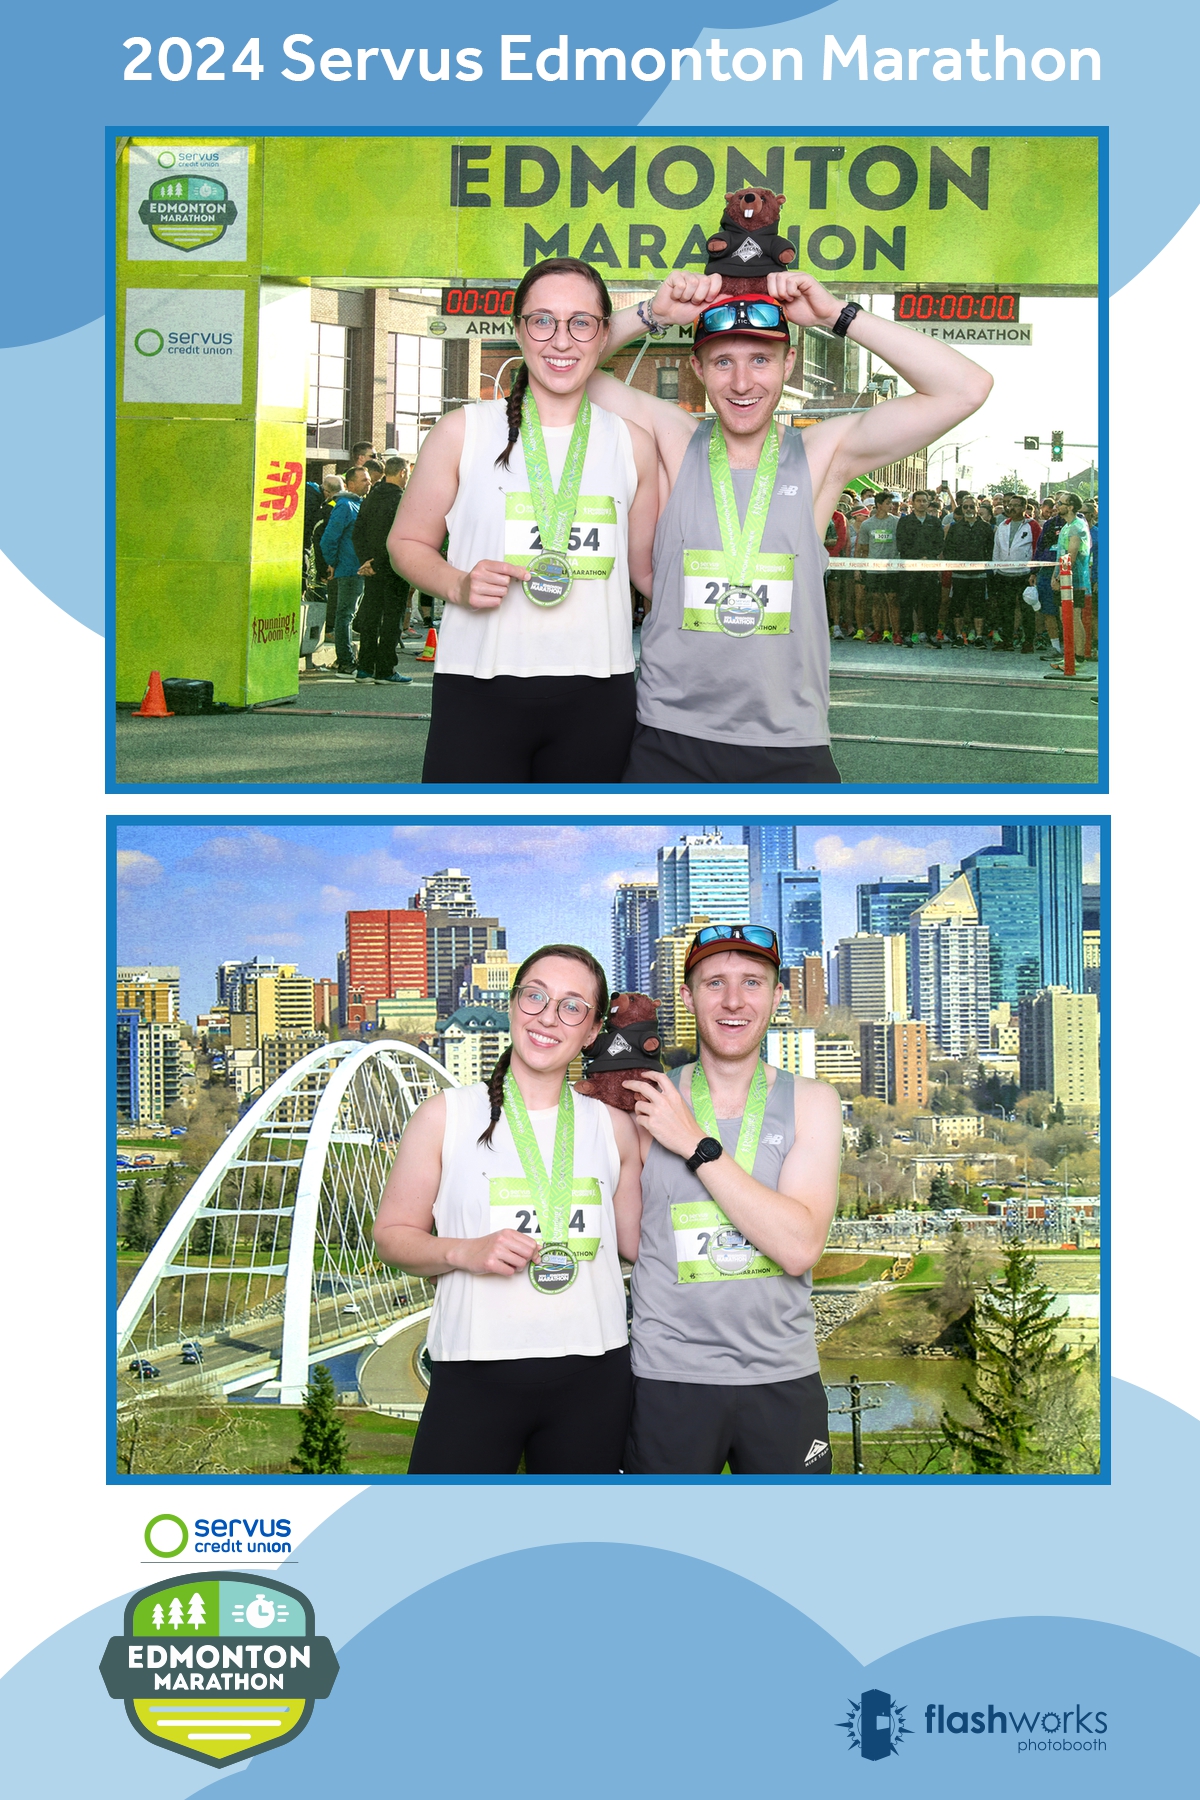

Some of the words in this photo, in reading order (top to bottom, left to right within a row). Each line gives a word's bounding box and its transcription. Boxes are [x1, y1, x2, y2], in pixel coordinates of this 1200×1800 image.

[178, 152, 220, 161] servus
[450, 144, 991, 211] EDMONTON
[149, 203, 227, 213] EDMONTON
[160, 214, 215, 222] MARATHON
[524, 223, 906, 271] MARAON
[168, 332, 233, 345] servus
[942, 328, 1031, 341] MARATHON
[168, 345, 200, 355] credit
[203, 347, 233, 355] union
[529, 526, 600, 551] 254
[257, 613, 290, 643] Running
